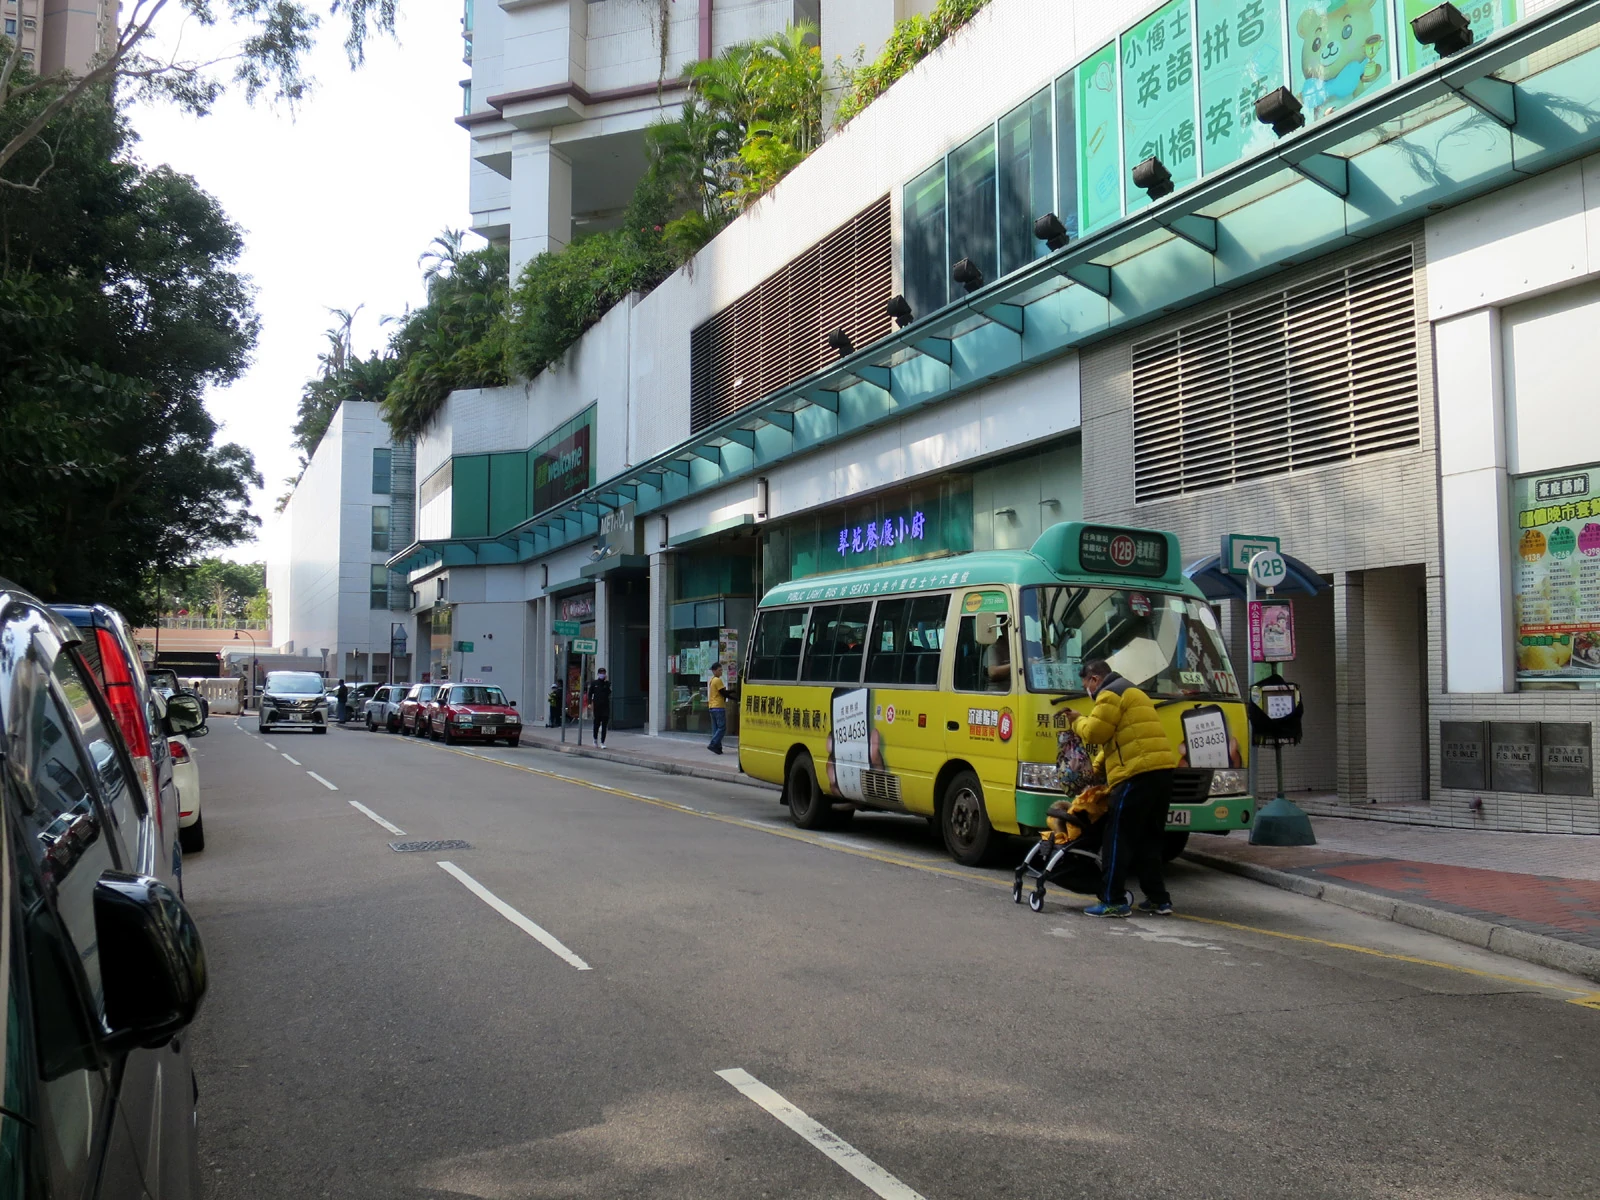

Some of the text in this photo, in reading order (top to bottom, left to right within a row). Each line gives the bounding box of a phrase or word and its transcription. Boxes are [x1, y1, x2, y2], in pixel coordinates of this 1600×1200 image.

[1125, 9, 1189, 69] 小博士
[837, 511, 925, 557] 翠苑餐廳小廚
[1113, 541, 1132, 561] 12B
[1253, 558, 1284, 578] 12B
[787, 591, 804, 602] PUBLIC
[806, 588, 823, 600] LIGHT
[825, 587, 837, 598] BUS
[849, 583, 871, 595] SEATS
[835, 720, 866, 744] 183 4633
[1190, 736, 1205, 749] 183
[1205, 731, 1225, 746] 4633
[1511, 753, 1531, 761] INLET
